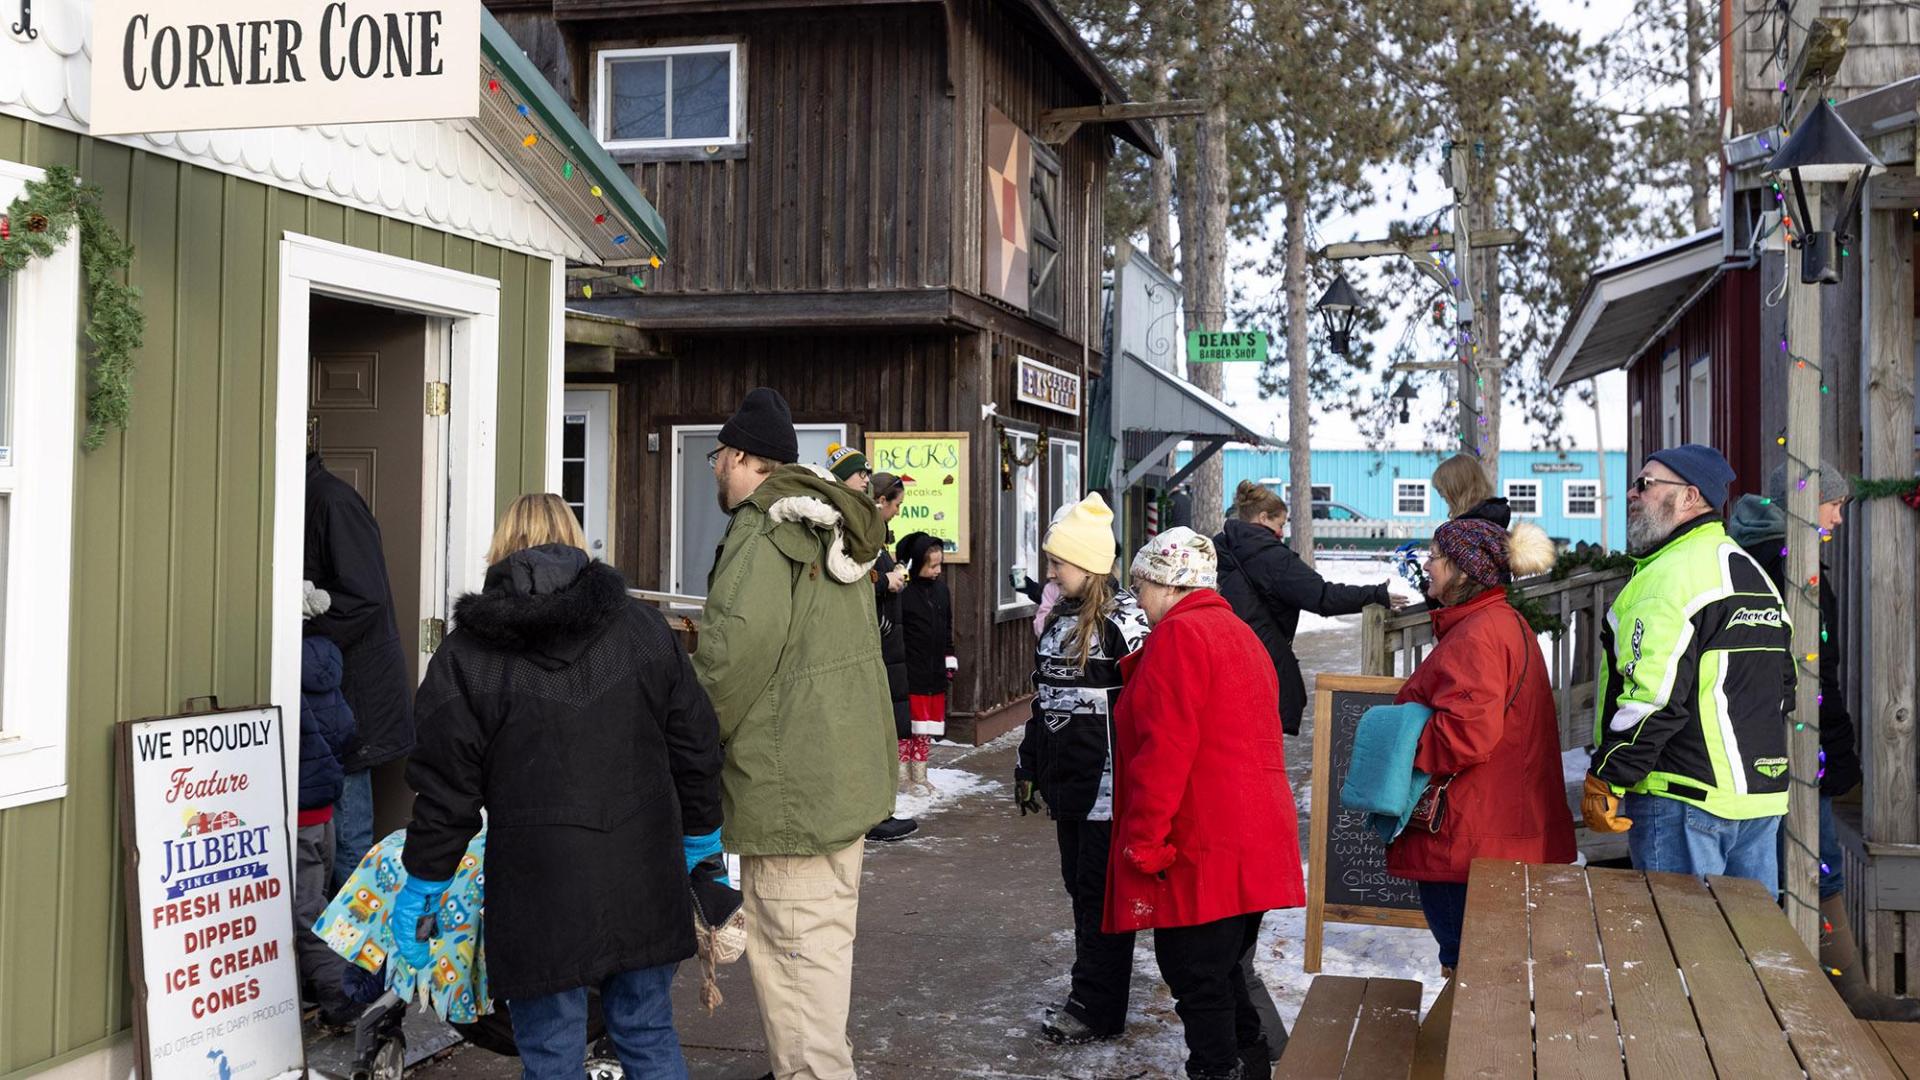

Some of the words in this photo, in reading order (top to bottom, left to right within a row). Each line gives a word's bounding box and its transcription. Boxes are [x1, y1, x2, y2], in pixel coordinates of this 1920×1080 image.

[123, 13, 306, 91] CORNER
[320, 2, 443, 82] CONE
[1199, 333, 1256, 347] DEAN'S
[901, 506, 929, 518] AND
[906, 488, 942, 497] ecakes
[912, 528, 947, 538] ORE
[137, 731, 172, 761] WE
[183, 720, 271, 756] PROUDLY
[165, 766, 249, 803] Feature
[160, 825, 271, 883] JILBERT
[178, 874, 219, 891] SINCE
[228, 863, 259, 878] 1937
[153, 892, 220, 929] FRESH
[229, 877, 281, 909] HAND
[184, 915, 257, 954] DIPPED
[165, 964, 201, 994] ICE
[210, 939, 279, 980] CREAM
[191, 978, 261, 1019] CONES
[154, 1042, 173, 1059] AND
[175, 1031, 204, 1053] OTHER
[206, 1023, 225, 1040] FINE
[226, 1013, 250, 1034] DAIRY
[252, 998, 296, 1024] PRODUCTS
